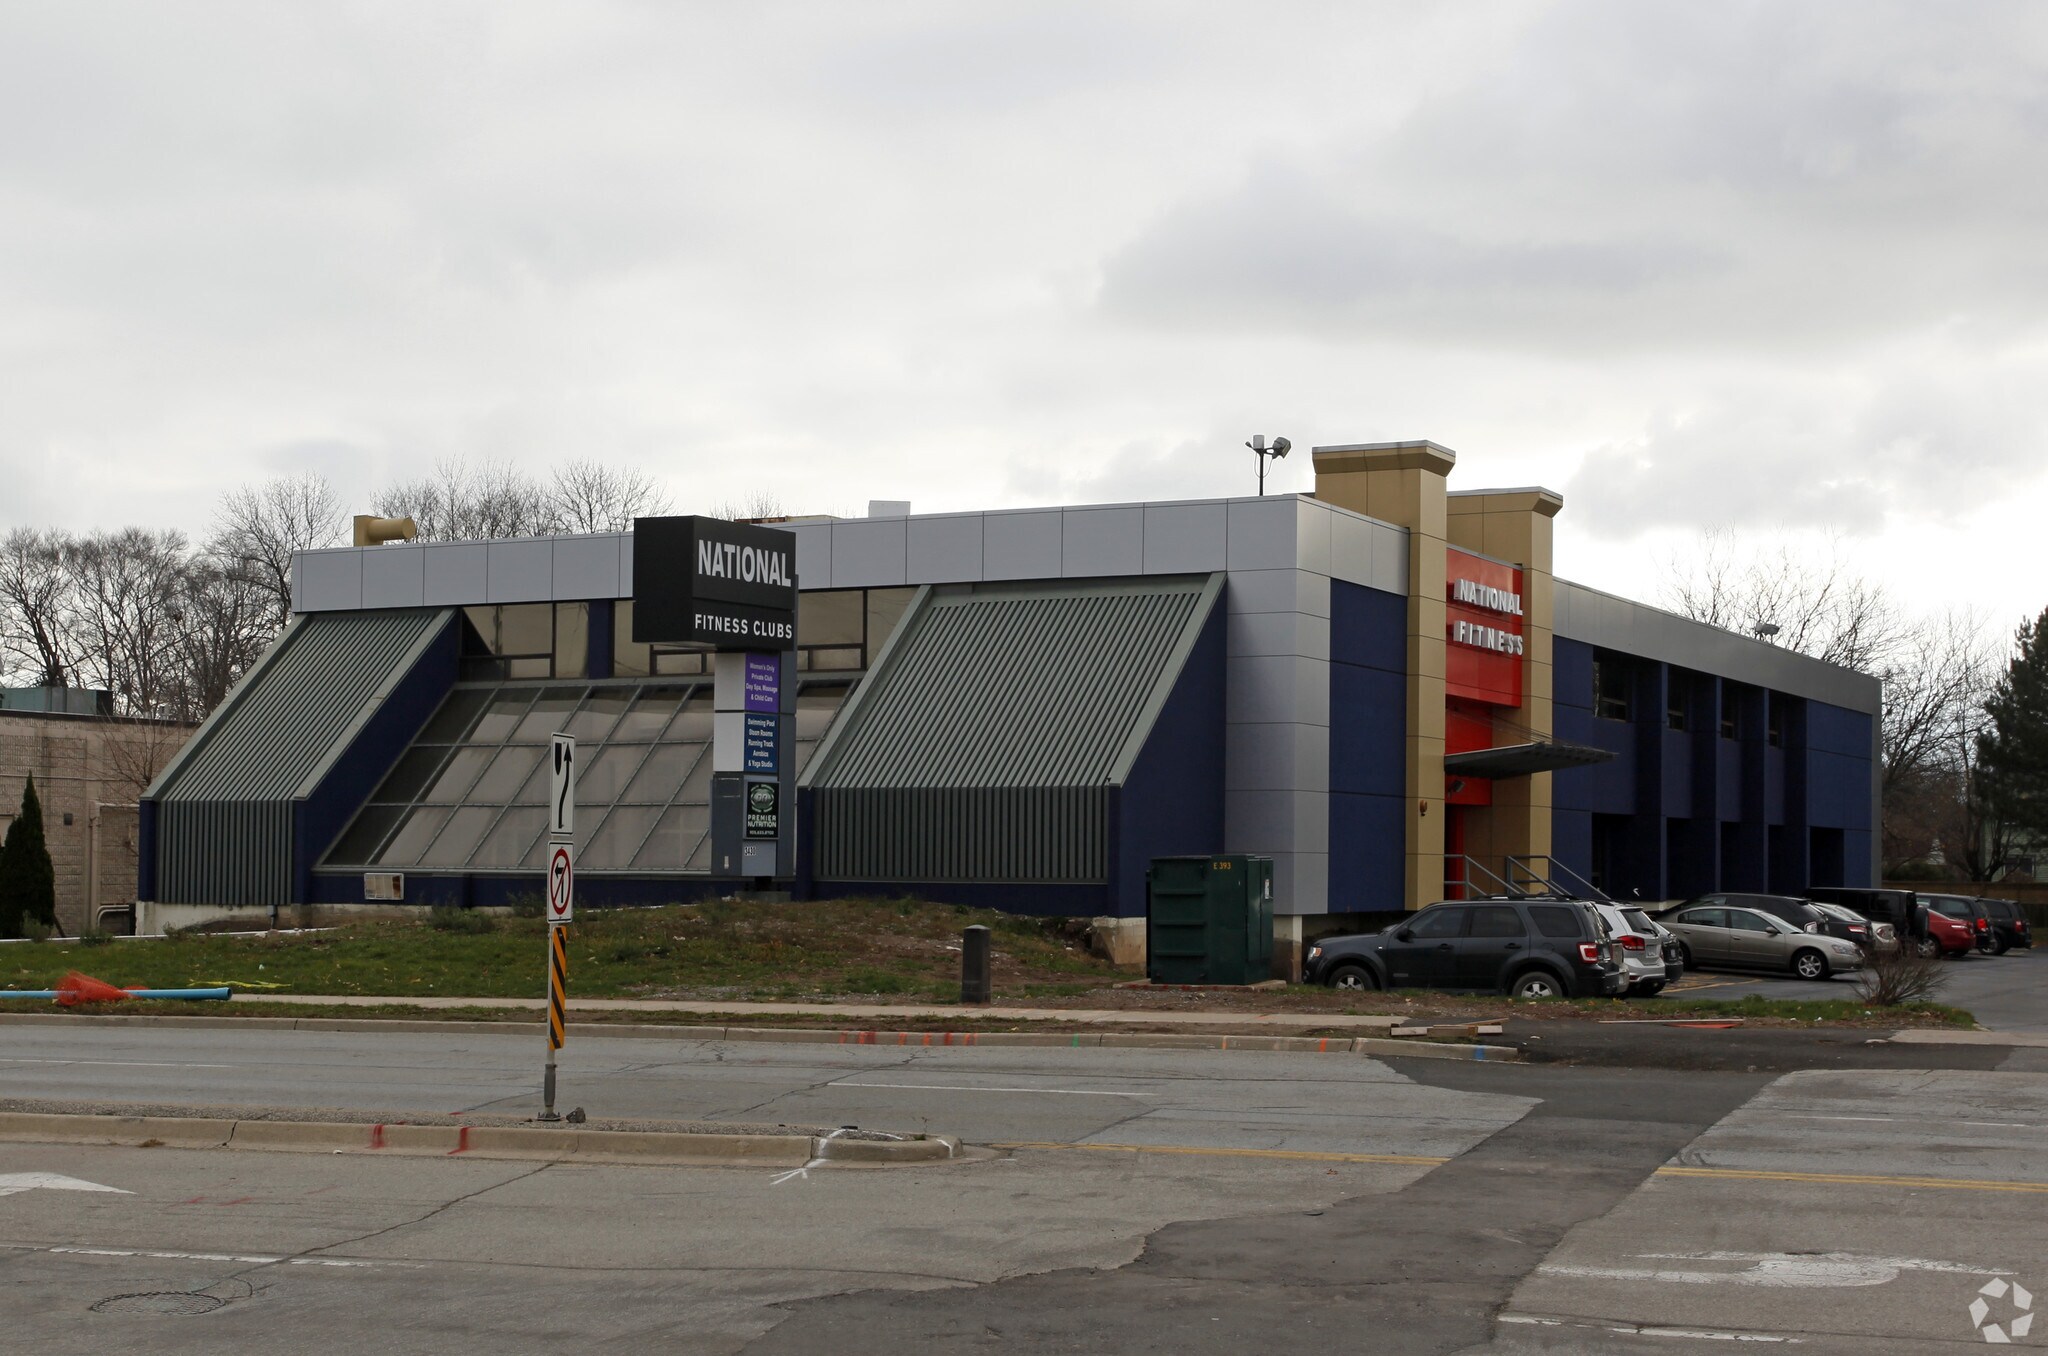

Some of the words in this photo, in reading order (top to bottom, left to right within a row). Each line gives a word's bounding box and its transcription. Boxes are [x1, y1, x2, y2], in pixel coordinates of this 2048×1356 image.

[698, 539, 791, 587] NATIONAL
[1457, 579, 1523, 615] NATIONAL
[695, 613, 748, 634] FITNESS
[753, 620, 792, 639] CLUBS
[1457, 621, 1523, 655] FITNESS
